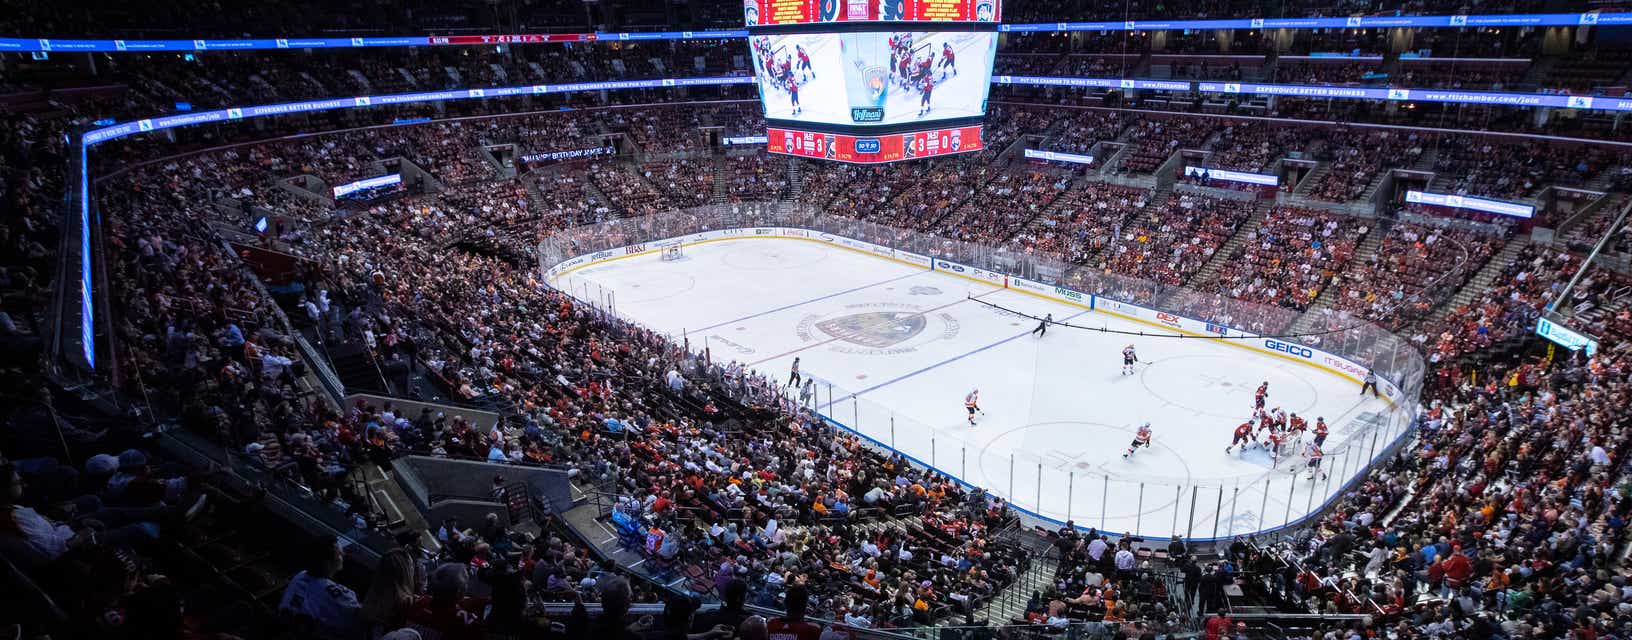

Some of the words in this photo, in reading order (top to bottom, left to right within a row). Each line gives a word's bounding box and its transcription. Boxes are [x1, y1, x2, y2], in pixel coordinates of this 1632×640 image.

[796, 136, 803, 151] 0
[816, 138, 824, 153] 3
[918, 138, 926, 152] 3
[941, 135, 949, 149] 0
[551, 149, 583, 160] BIRTHDAY
[1156, 312, 1181, 324] DEX
[1265, 340, 1313, 359] GEICO
